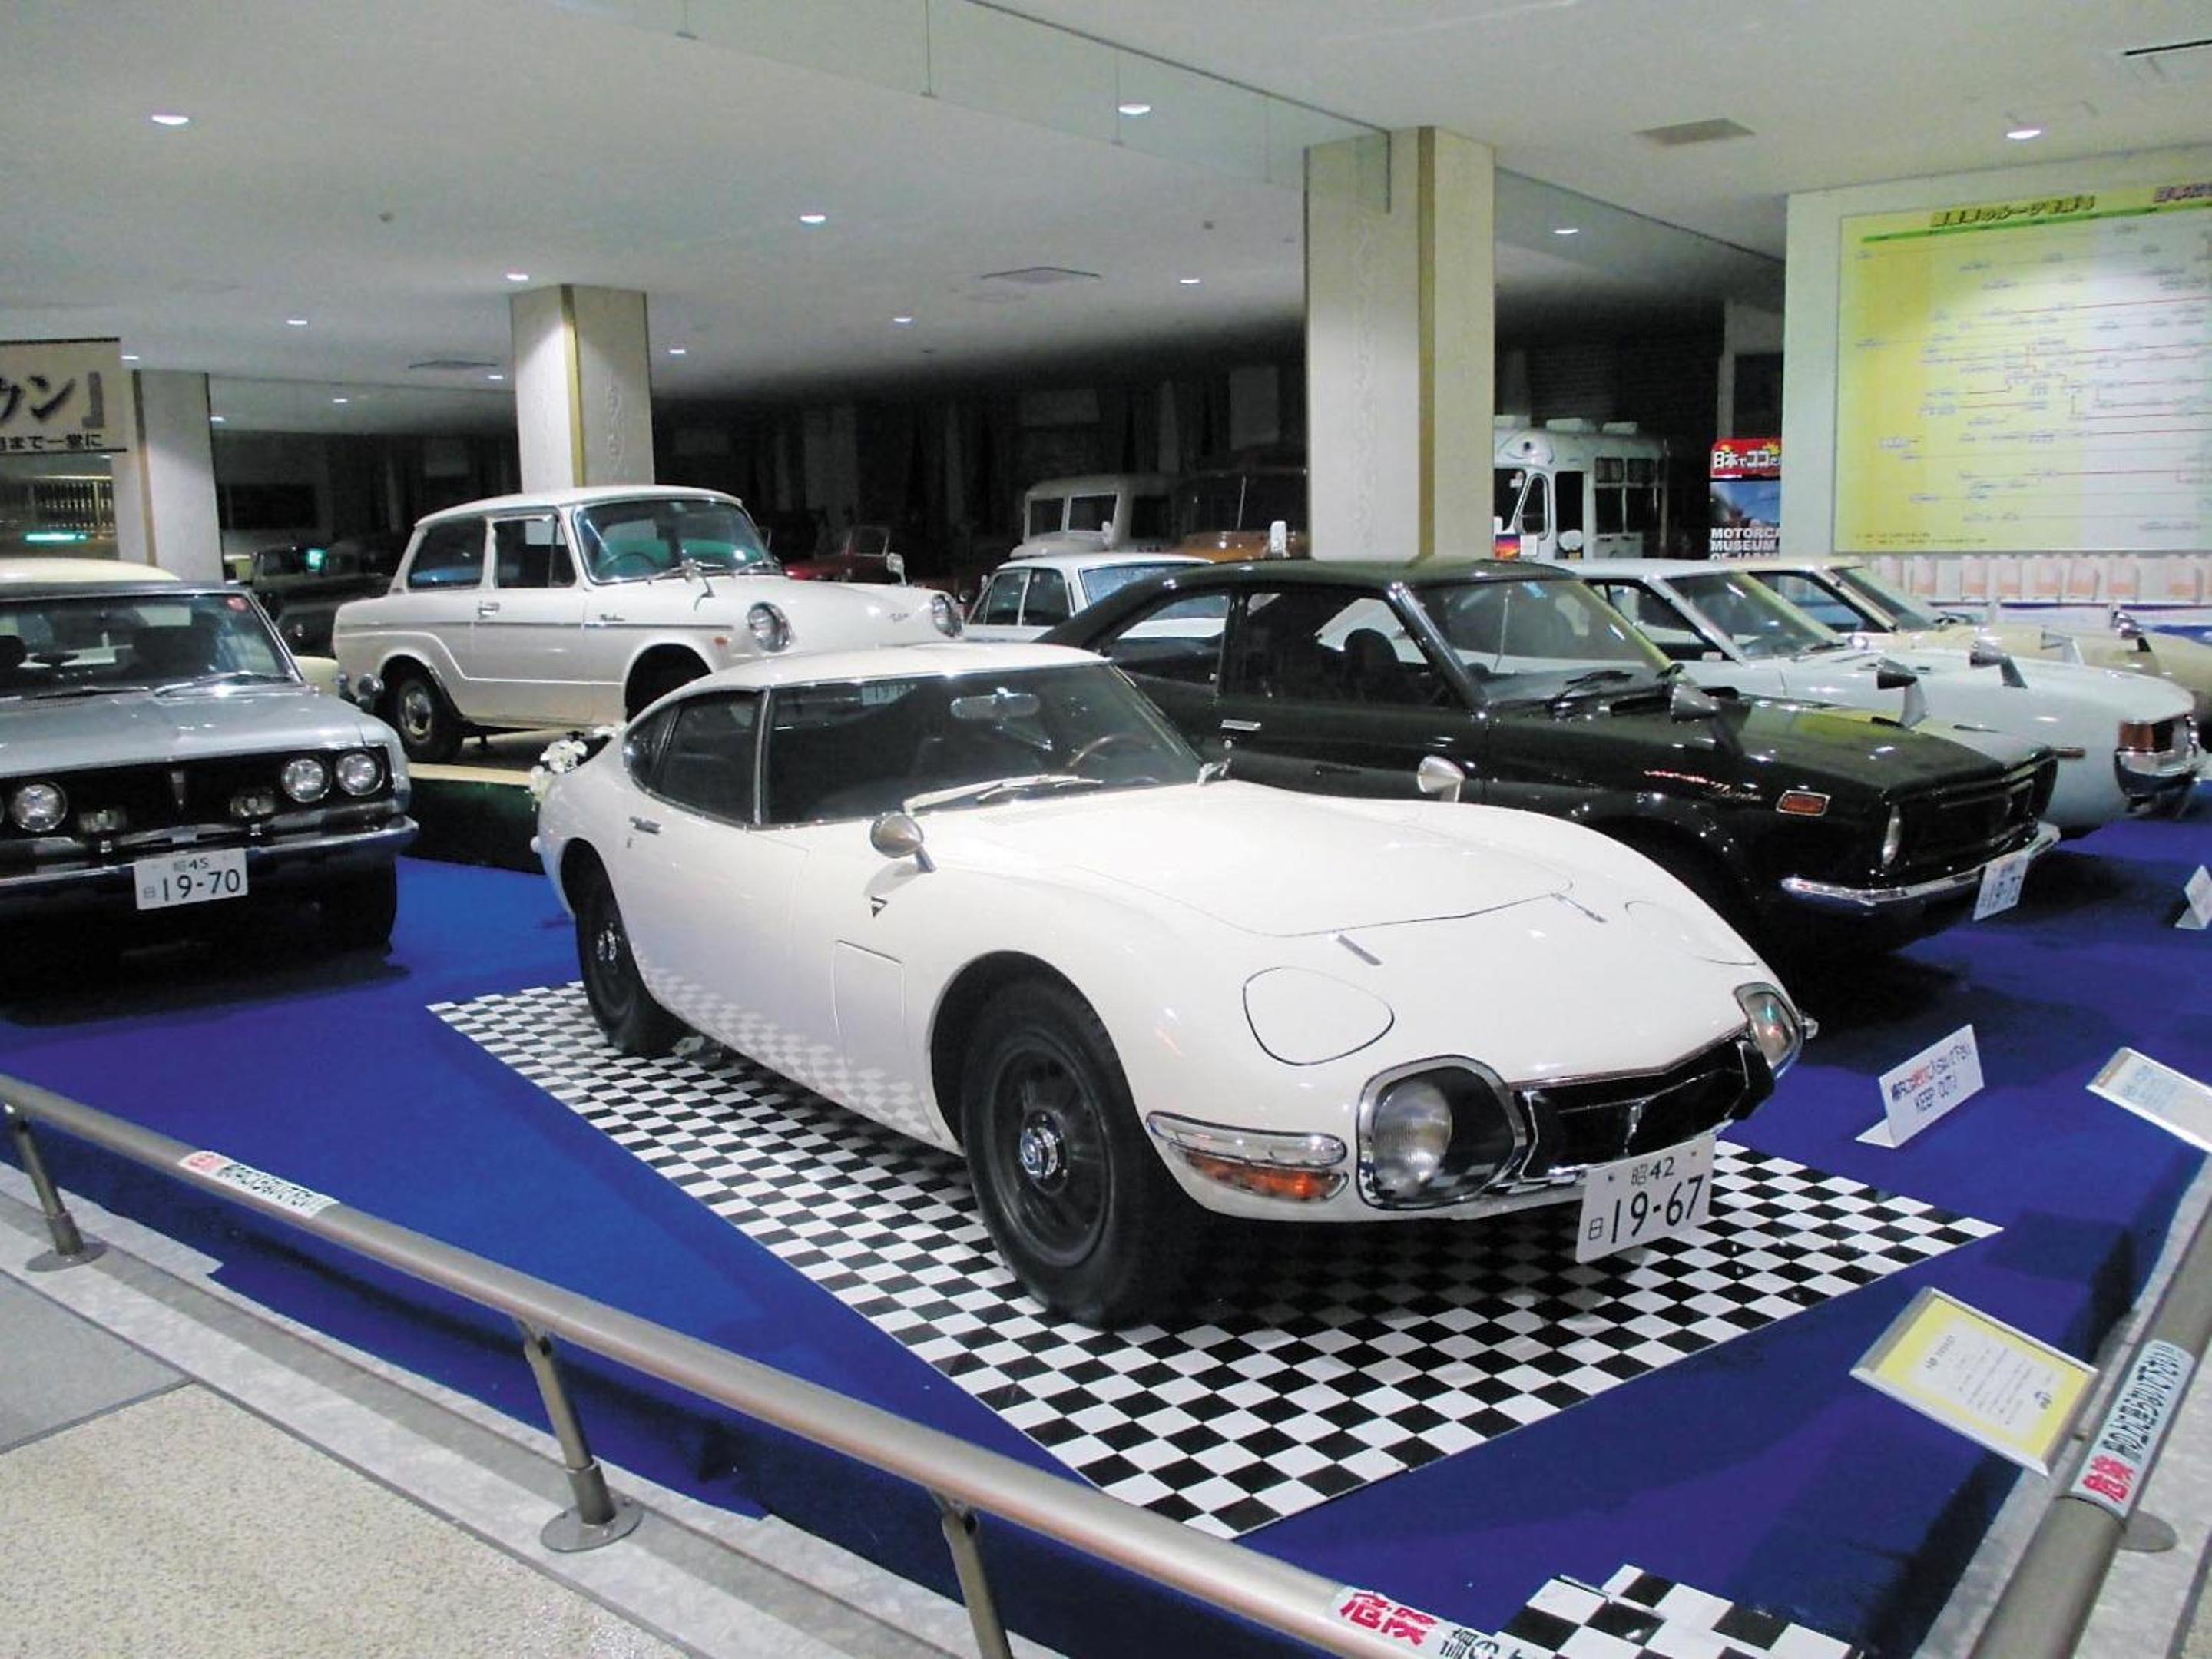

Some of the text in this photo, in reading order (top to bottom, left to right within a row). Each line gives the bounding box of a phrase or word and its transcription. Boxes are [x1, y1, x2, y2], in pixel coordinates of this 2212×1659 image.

[1710, 539, 1777, 551] MUSEUM
[162, 869, 240, 902] 19-70
[1611, 1174, 1704, 1244] 19-67
[1340, 1592, 1438, 1646] 危険
